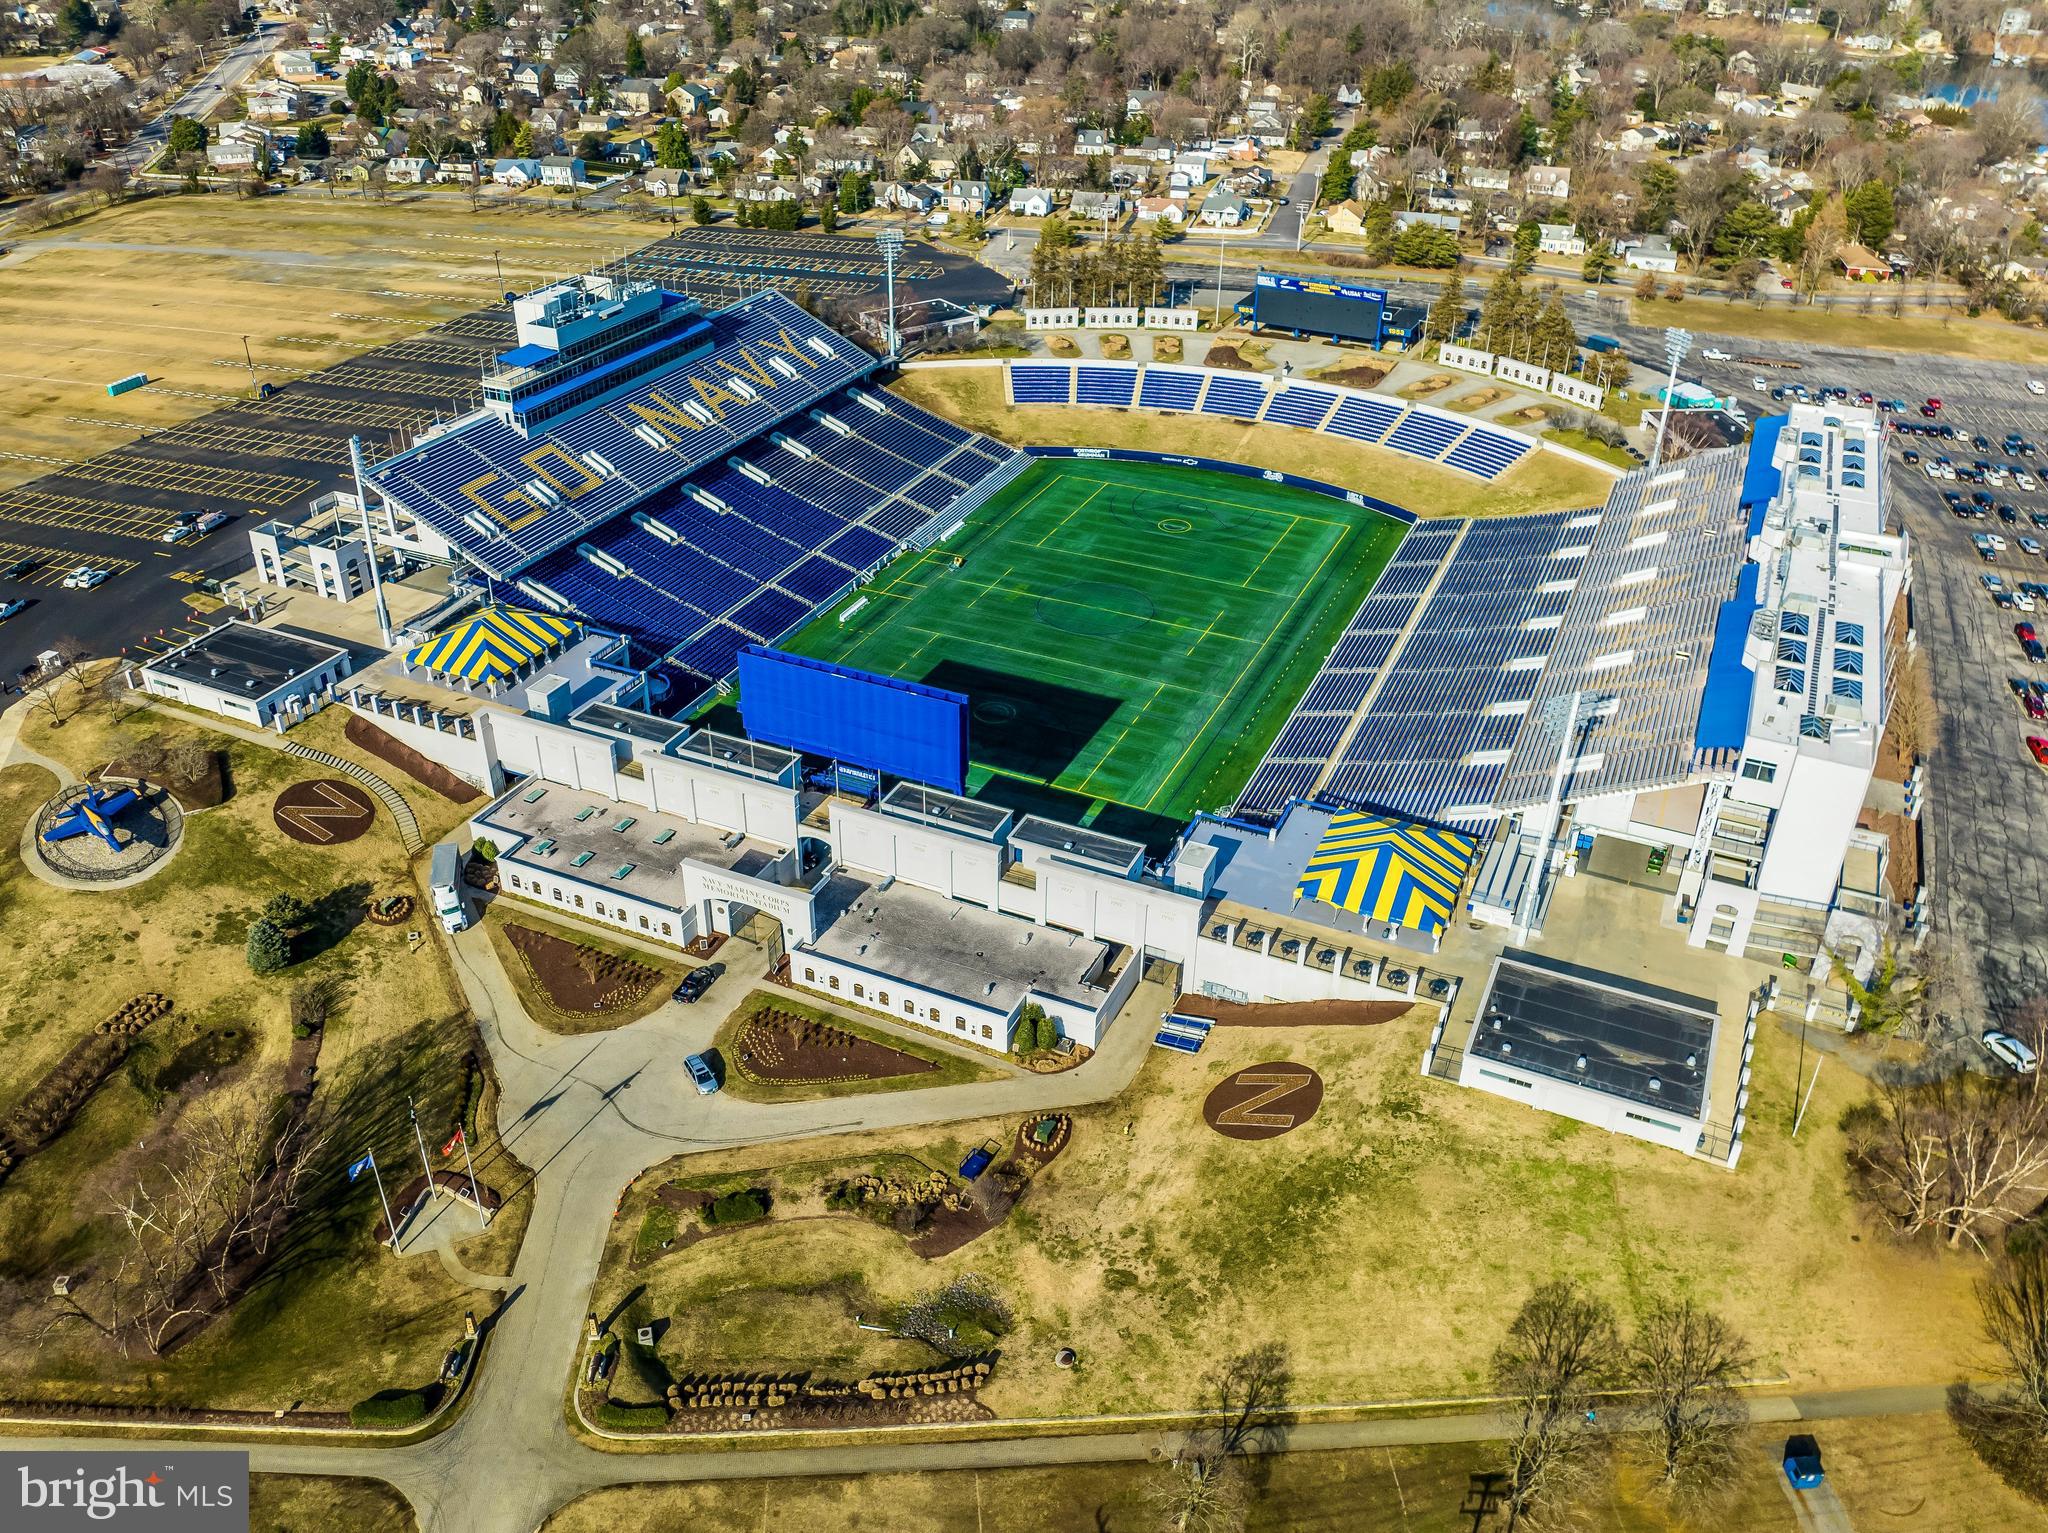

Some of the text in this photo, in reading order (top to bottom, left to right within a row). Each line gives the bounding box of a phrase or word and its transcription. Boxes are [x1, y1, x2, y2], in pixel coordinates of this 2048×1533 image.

[459, 329, 820, 532] GO NAVY
[703, 883, 790, 915] MEMORIAL STADIUM
[762, 894, 790, 908] CORPS
